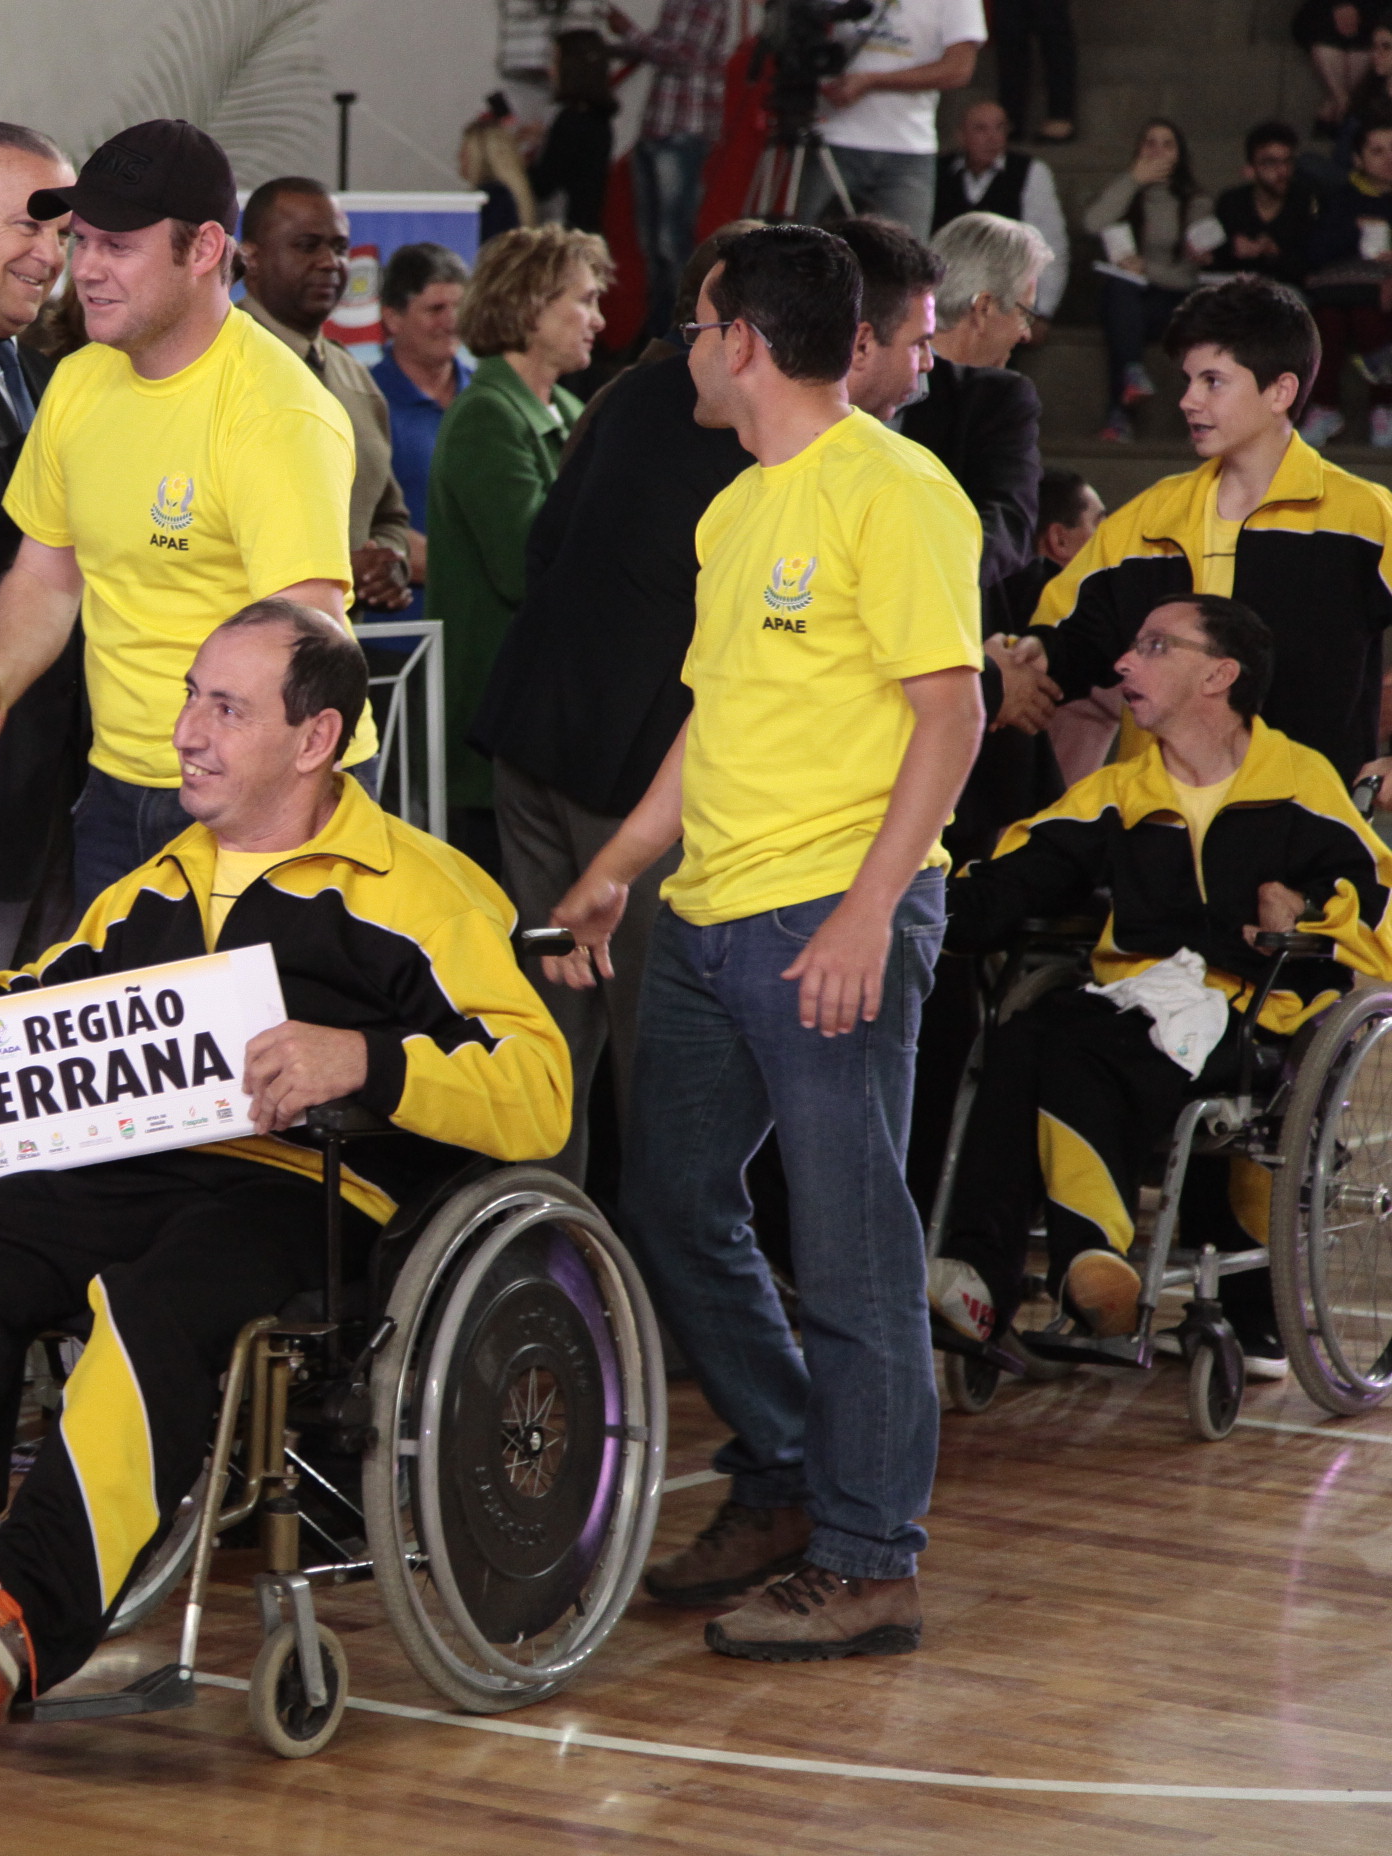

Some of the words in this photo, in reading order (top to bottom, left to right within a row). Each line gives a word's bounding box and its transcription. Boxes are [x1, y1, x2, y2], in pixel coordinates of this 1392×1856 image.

[150, 533, 189, 551] APAE
[762, 616, 807, 634] APAE
[24, 985, 185, 1056] REGIÃO
